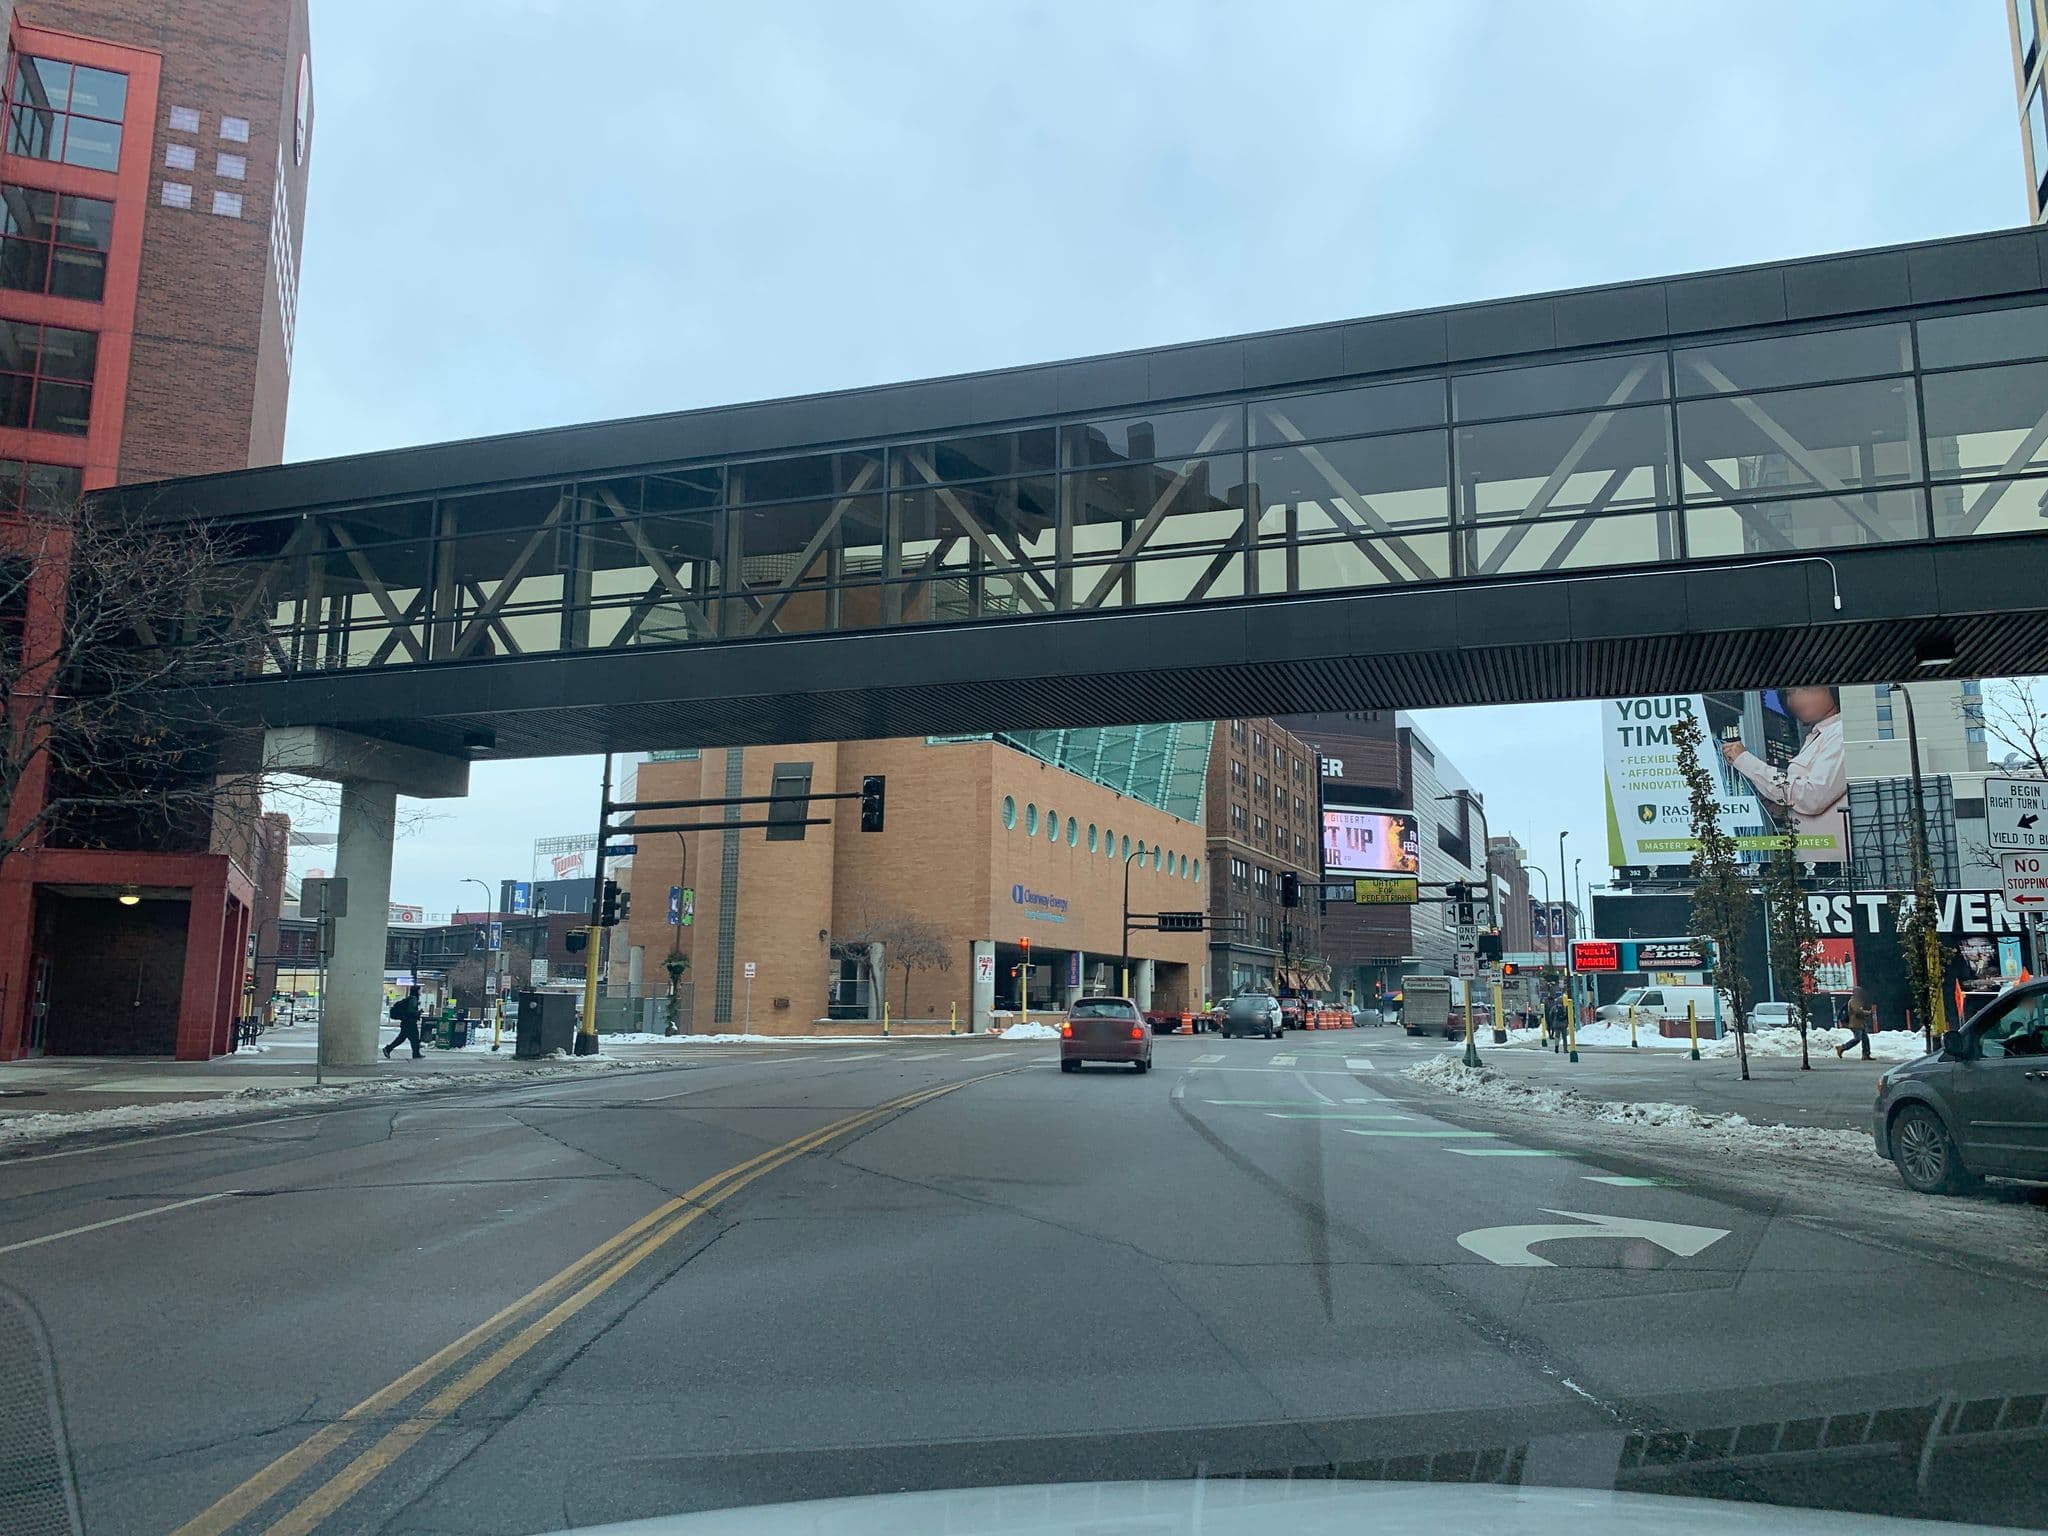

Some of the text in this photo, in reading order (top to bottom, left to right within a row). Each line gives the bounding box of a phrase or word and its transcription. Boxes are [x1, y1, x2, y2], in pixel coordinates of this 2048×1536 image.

[1615, 697, 1693, 720] YOUR
[1617, 724, 1680, 747] TIM
[1627, 754, 1678, 764] FLEXIBLE
[1628, 767, 1680, 777] AFFORDA
[1629, 780, 1689, 790] INNOVATIV
[2010, 785, 2040, 797] BEGIN
[1662, 803, 1750, 816] RASSSEN
[1990, 796, 2013, 808] RIGHT
[2018, 798, 2038, 810] TURN
[1346, 827, 1373, 852] UP
[1993, 832, 2018, 844] YIELD
[2024, 834, 2034, 845] TO
[1644, 842, 1689, 850] MASTER'S
[2014, 858, 2040, 873] NO
[1772, 895, 1887, 933] RST
[1577, 957, 1615, 966] PARKING
[981, 964, 988, 976] 7
